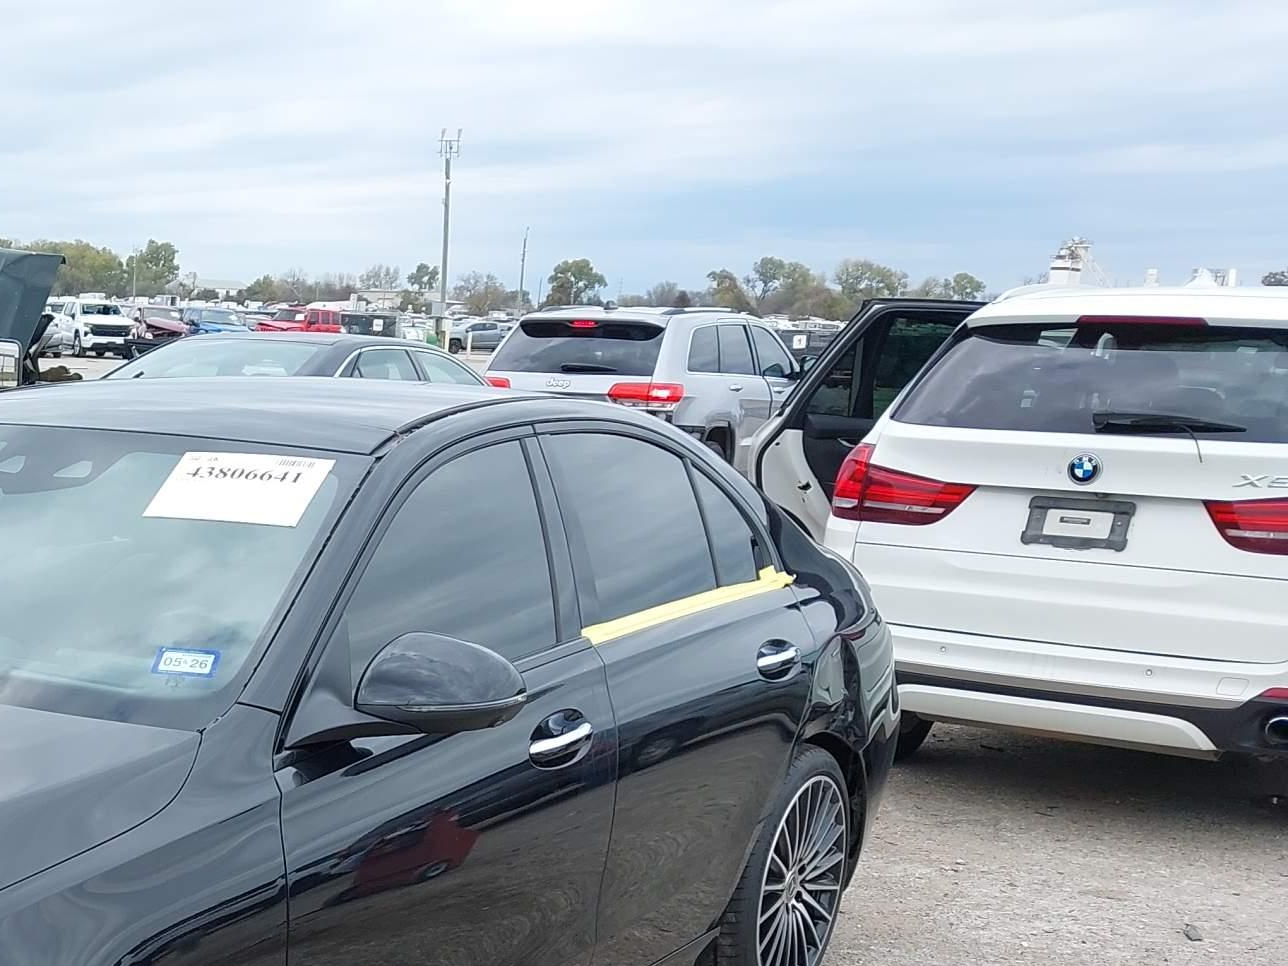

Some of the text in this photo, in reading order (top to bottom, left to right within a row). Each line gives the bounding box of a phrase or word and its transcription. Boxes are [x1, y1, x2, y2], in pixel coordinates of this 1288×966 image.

[545, 376, 571, 389] Jeep
[186, 466, 303, 484] 43806641
[163, 656, 209, 669] 05 26
